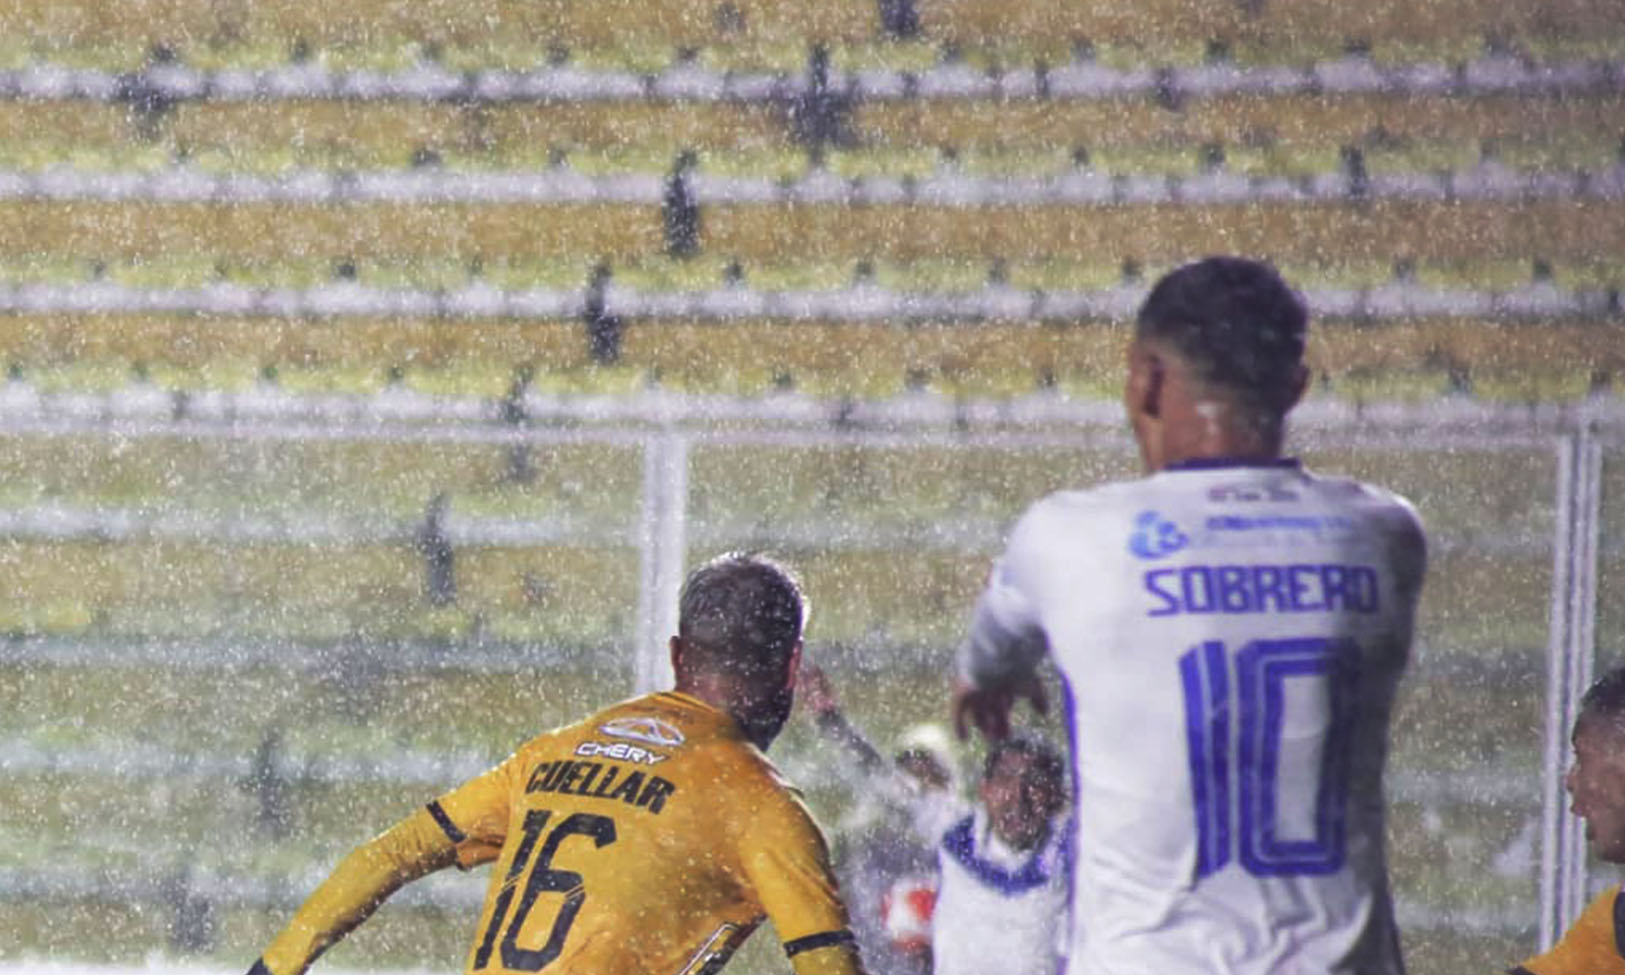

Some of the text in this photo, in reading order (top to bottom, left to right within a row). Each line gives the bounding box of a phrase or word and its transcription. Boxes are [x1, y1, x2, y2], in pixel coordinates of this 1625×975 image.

[1143, 563, 1380, 618] SOBRERO
[575, 741, 669, 766] CHERY
[1178, 636, 1362, 879] 10
[525, 759, 676, 815] CUELLAR
[473, 808, 618, 973] 16
